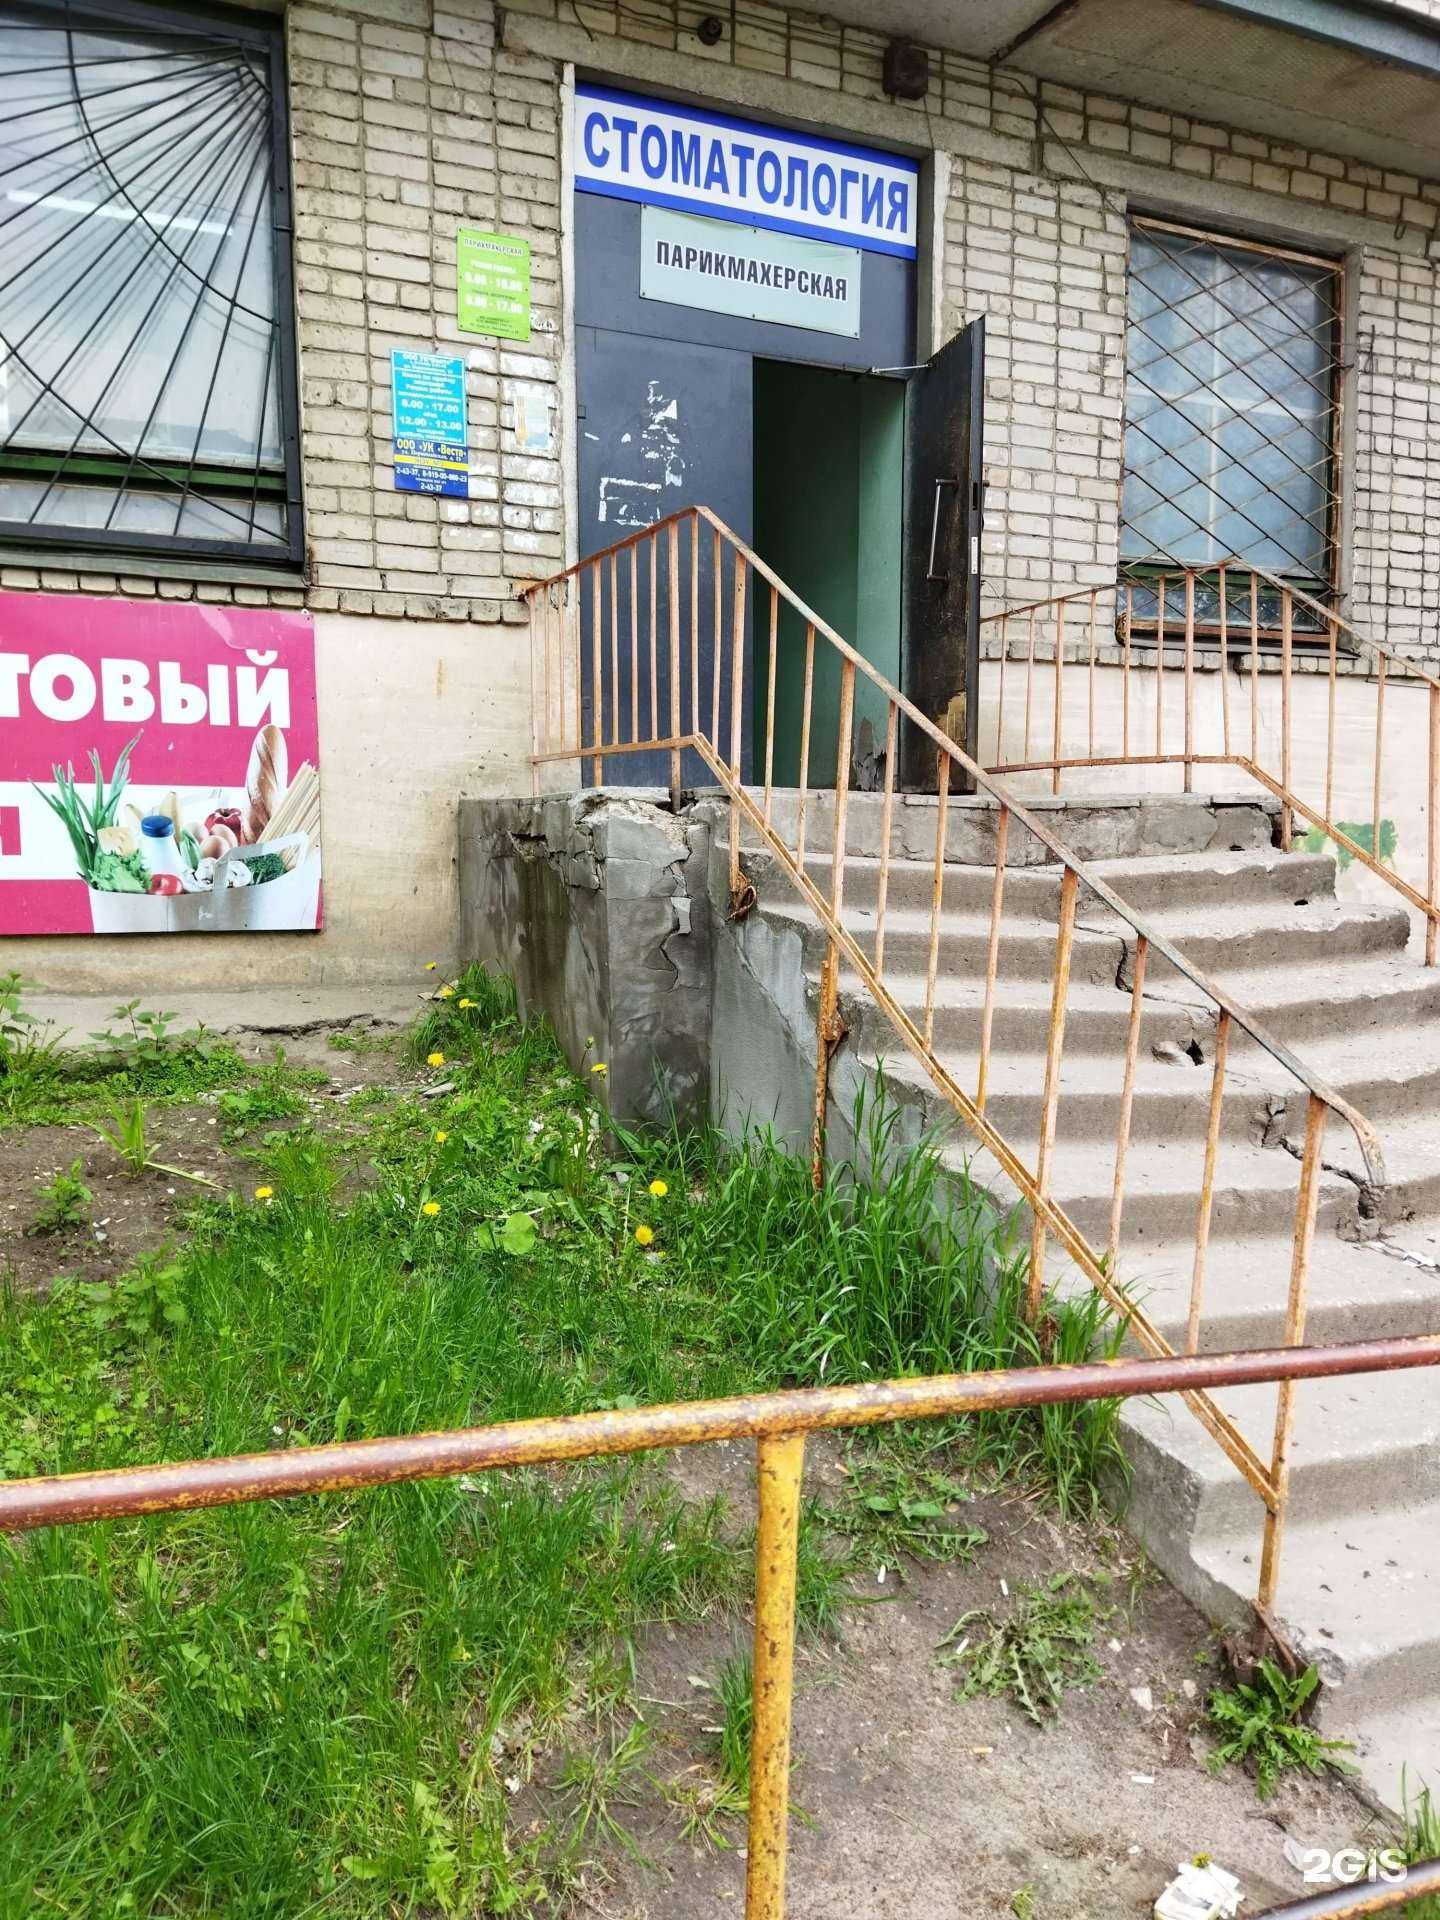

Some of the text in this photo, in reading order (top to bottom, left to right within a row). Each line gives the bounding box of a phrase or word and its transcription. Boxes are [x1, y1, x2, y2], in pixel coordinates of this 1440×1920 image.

[583, 111, 909, 234] СТОМАТОЛОГИЯ
[656, 240, 848, 302] ПАРИКМАХЕРСКАЯ
[431, 403, 459, 414] 17.00
[397, 438, 415, 450] ООО
